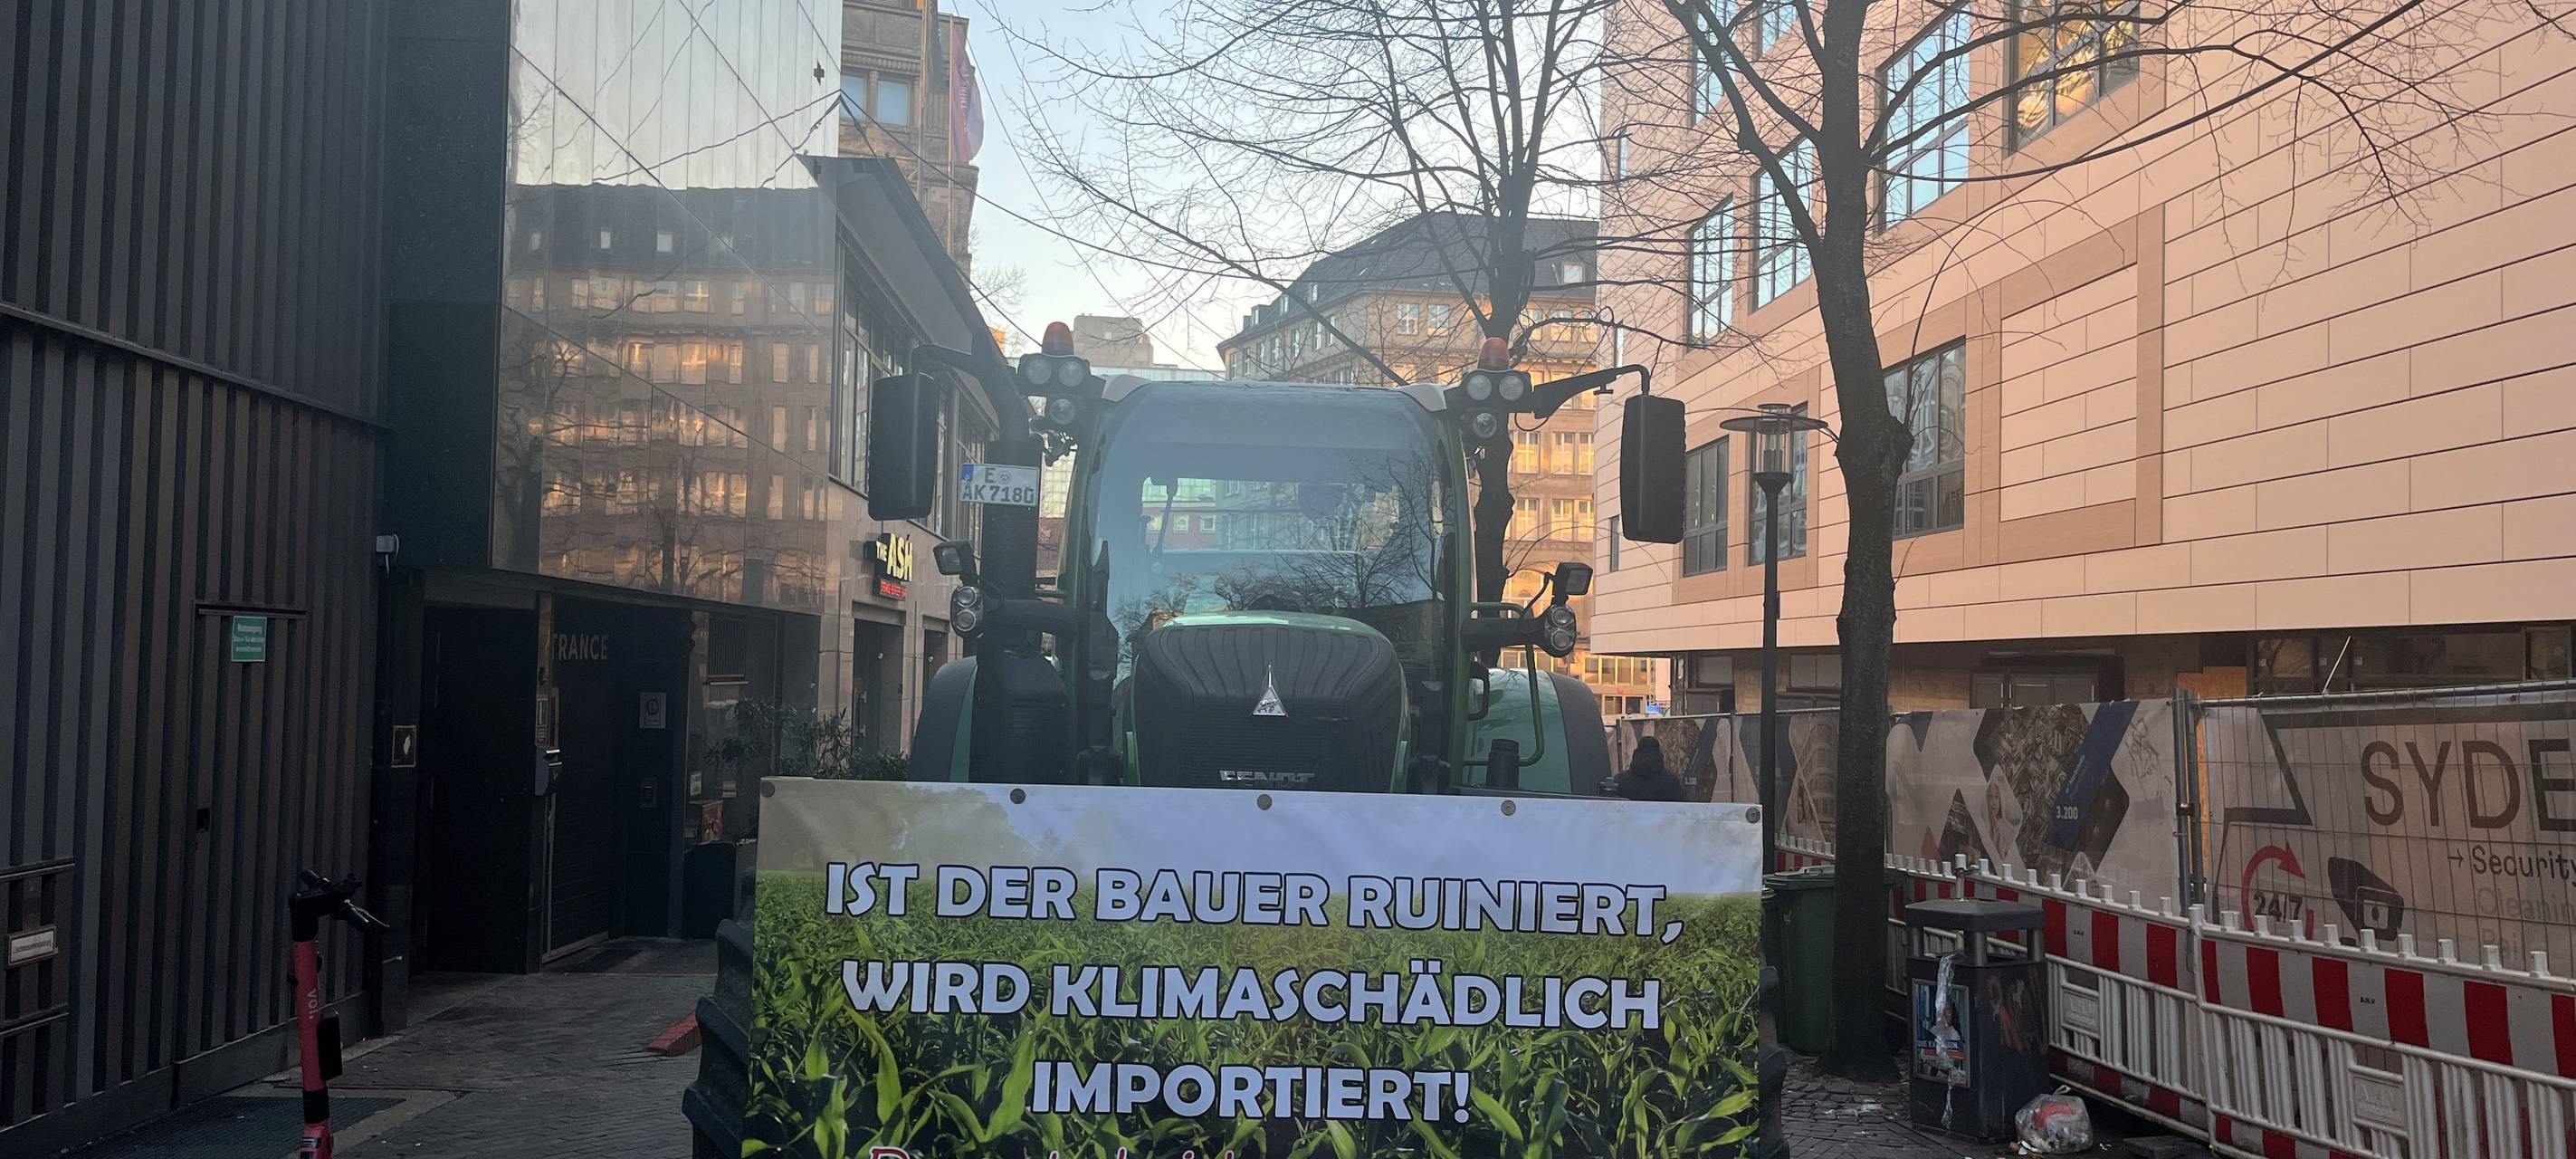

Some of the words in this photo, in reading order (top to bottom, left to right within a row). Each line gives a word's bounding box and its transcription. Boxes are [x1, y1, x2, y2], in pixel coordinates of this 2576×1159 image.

[963, 484, 986, 501] AK
[985, 467, 996, 484] E
[876, 541, 887, 561] THE
[887, 533, 912, 582] ASH
[2361, 740, 2576, 831] SYDE
[2056, 805, 2079, 820] 3.200
[825, 862, 920, 917] IST
[936, 864, 1079, 920] DER
[1094, 868, 1330, 927] BAUER
[1347, 874, 1684, 944] RUINIERT,
[2254, 891, 2303, 923] 24/7
[841, 959, 1032, 1015] WIRD
[1050, 958, 1660, 1030] KLIMASCHÄDLICH
[1031, 1060, 1471, 1124] IMPORTIERT!
